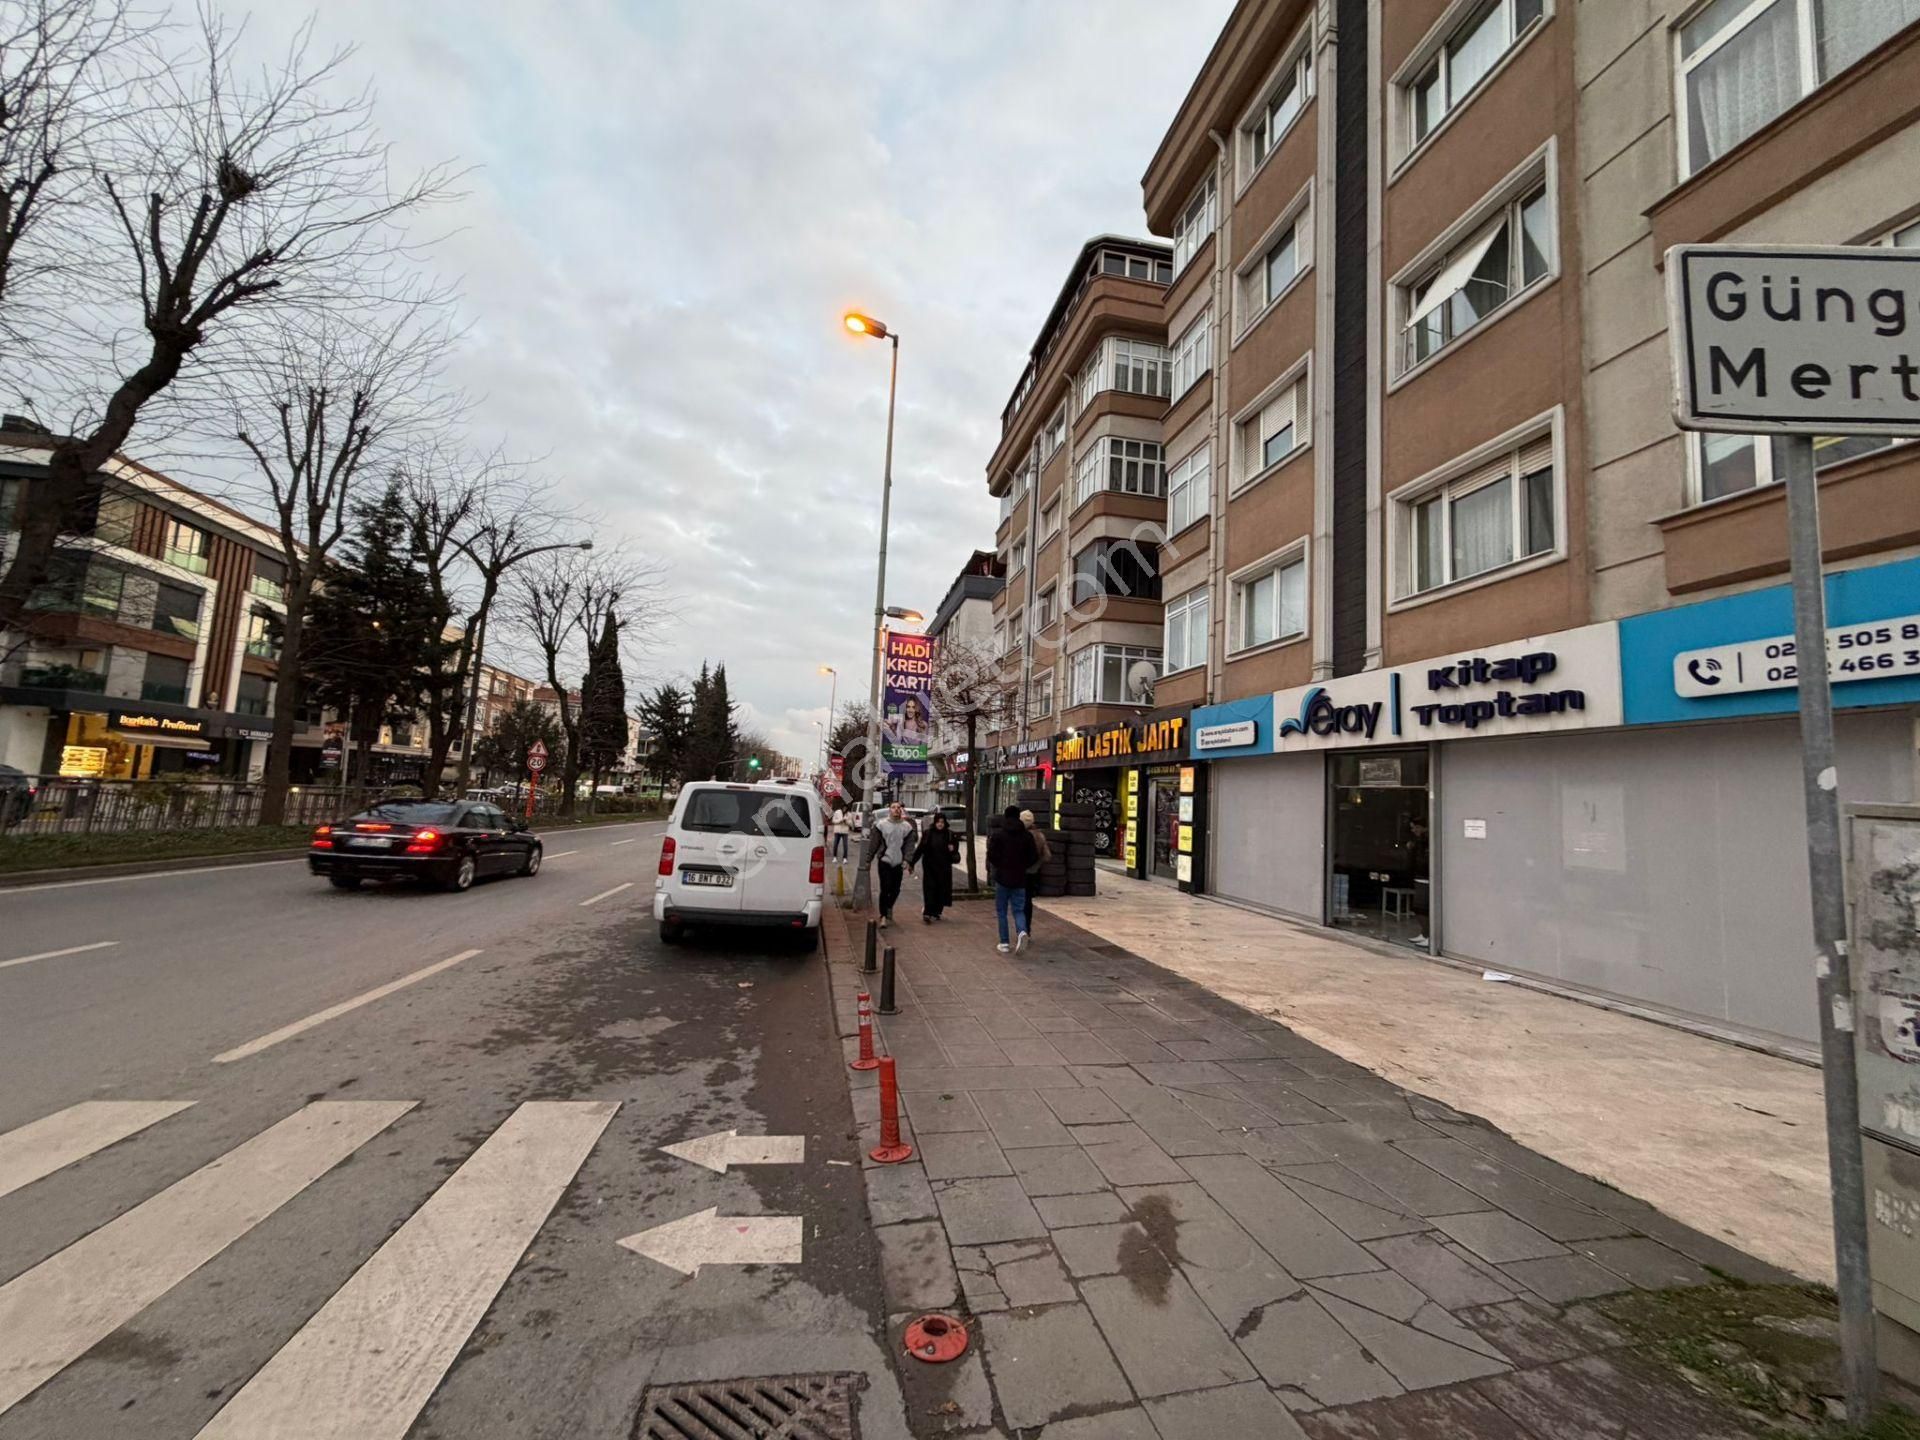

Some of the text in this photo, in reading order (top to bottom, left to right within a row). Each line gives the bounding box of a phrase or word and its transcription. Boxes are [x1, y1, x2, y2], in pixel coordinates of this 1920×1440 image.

[1706, 271, 1920, 337] Güng
[1709, 345, 1919, 402] Mert
[891, 641, 931, 659] HADİ
[1765, 638, 1829, 659] 02
[1838, 628, 1892, 649] 505
[886, 657, 932, 675] KREDİ
[1428, 651, 1557, 691] Kitap
[1767, 663, 1833, 682] 02
[1839, 654, 1894, 672] 466
[886, 674, 931, 690] KARTI
[1410, 689, 1585, 728] Toptan
[1087, 722, 1132, 758] LASTİK
[825, 783, 835, 791] 20
[688, 872, 696, 881] 16
